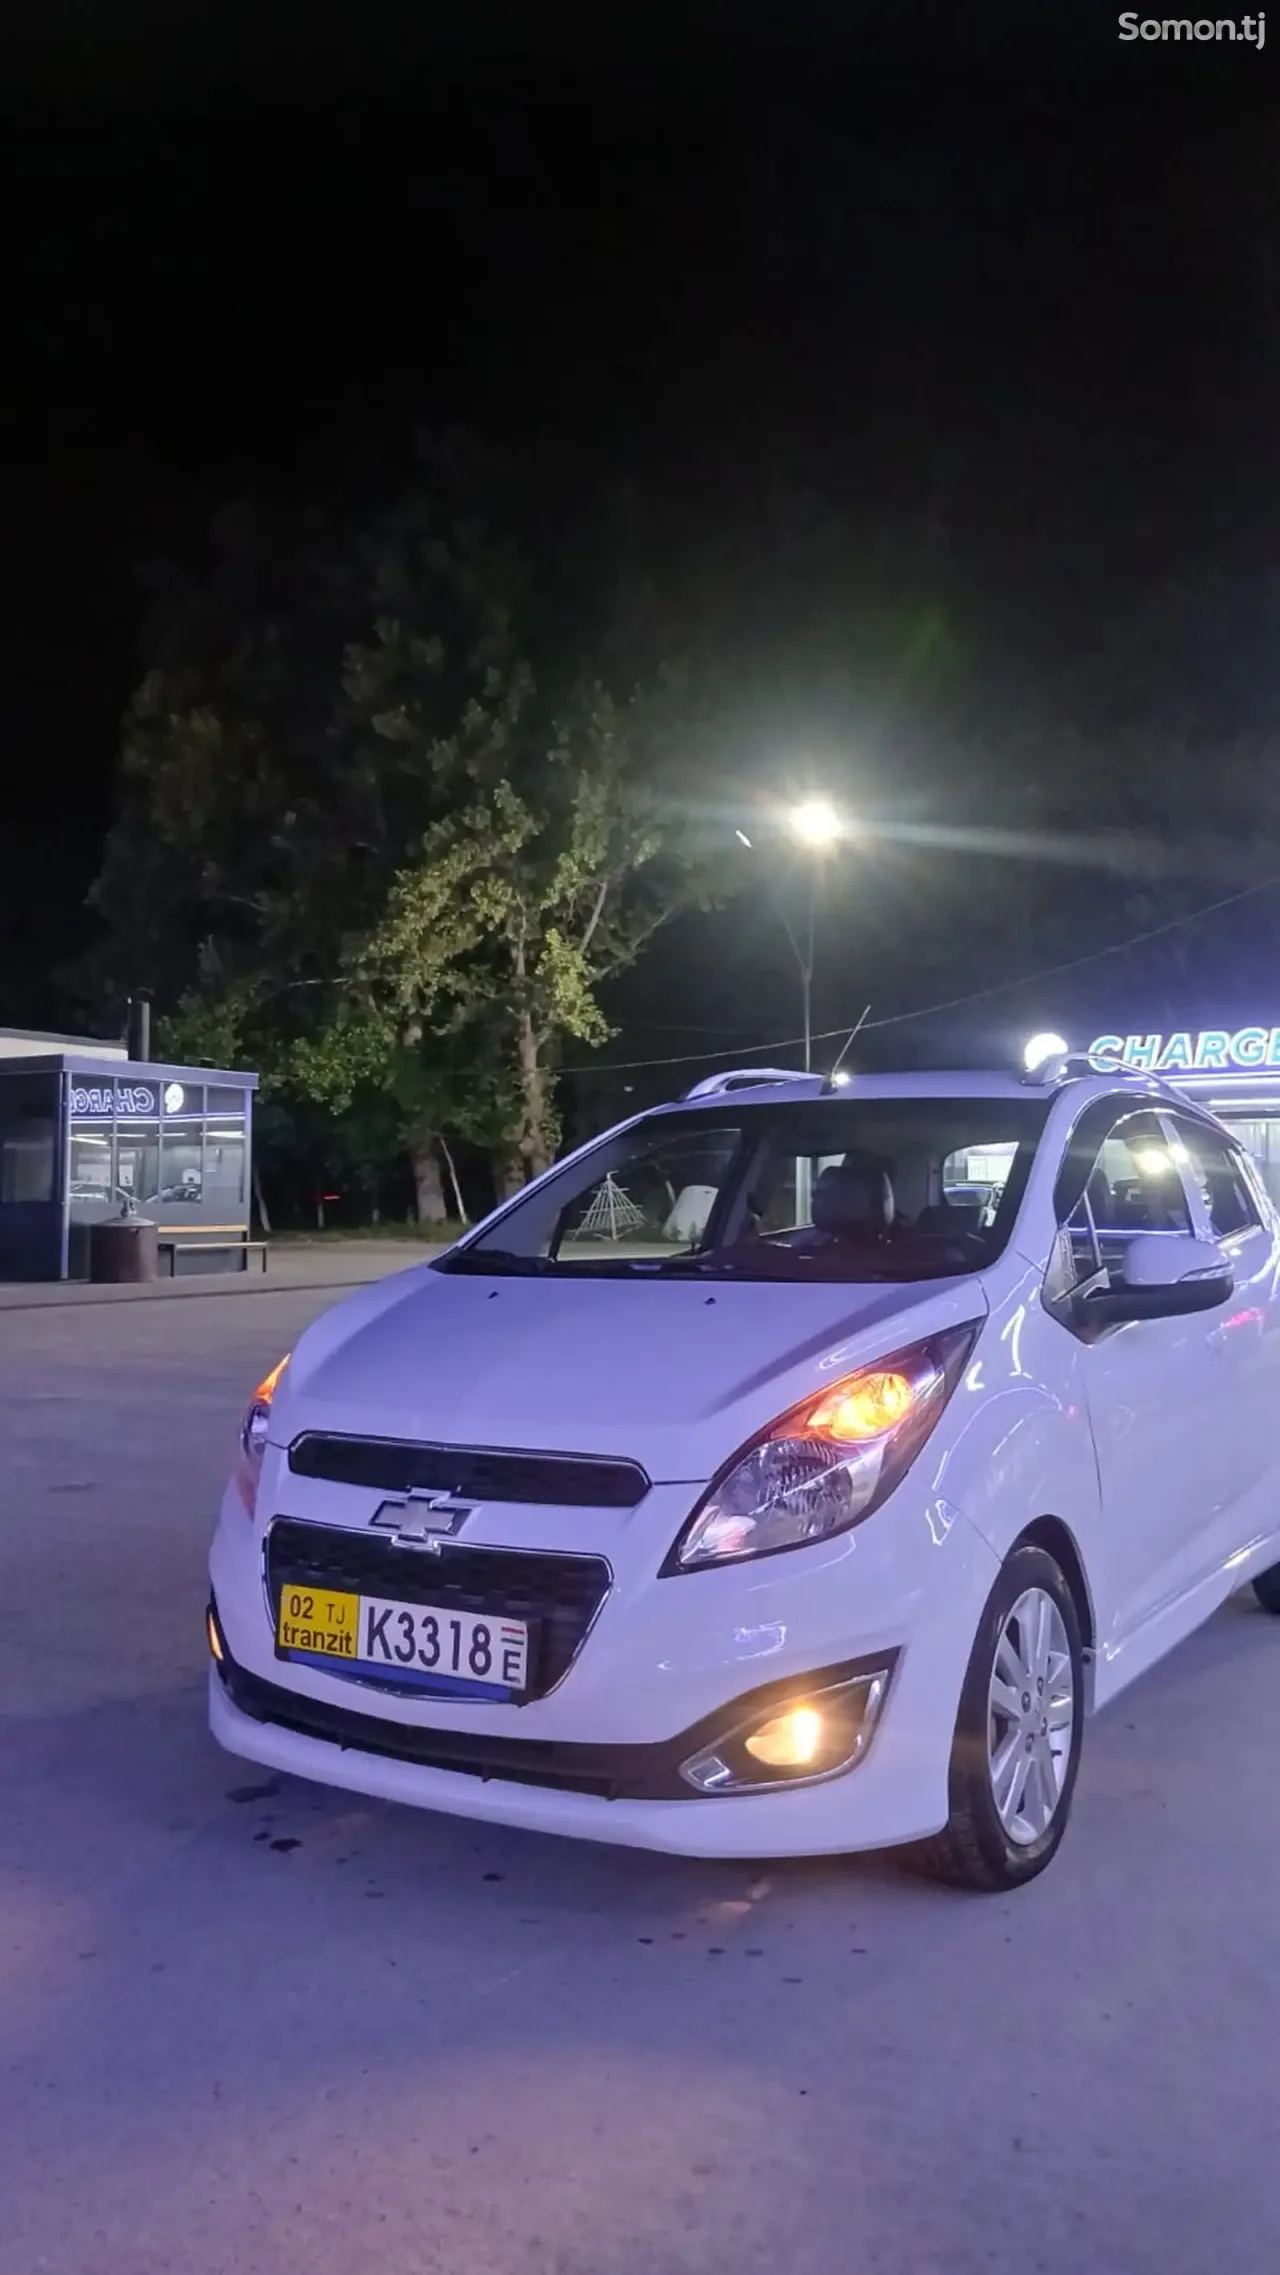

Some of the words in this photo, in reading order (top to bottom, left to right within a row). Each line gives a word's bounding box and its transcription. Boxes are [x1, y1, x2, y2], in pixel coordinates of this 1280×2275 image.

[290, 1594, 313, 1620] 02
[327, 1603, 345, 1625] TJ
[283, 1622, 352, 1654] tranzit
[367, 1606, 492, 1676] K3318
[503, 1650, 521, 1683] E
